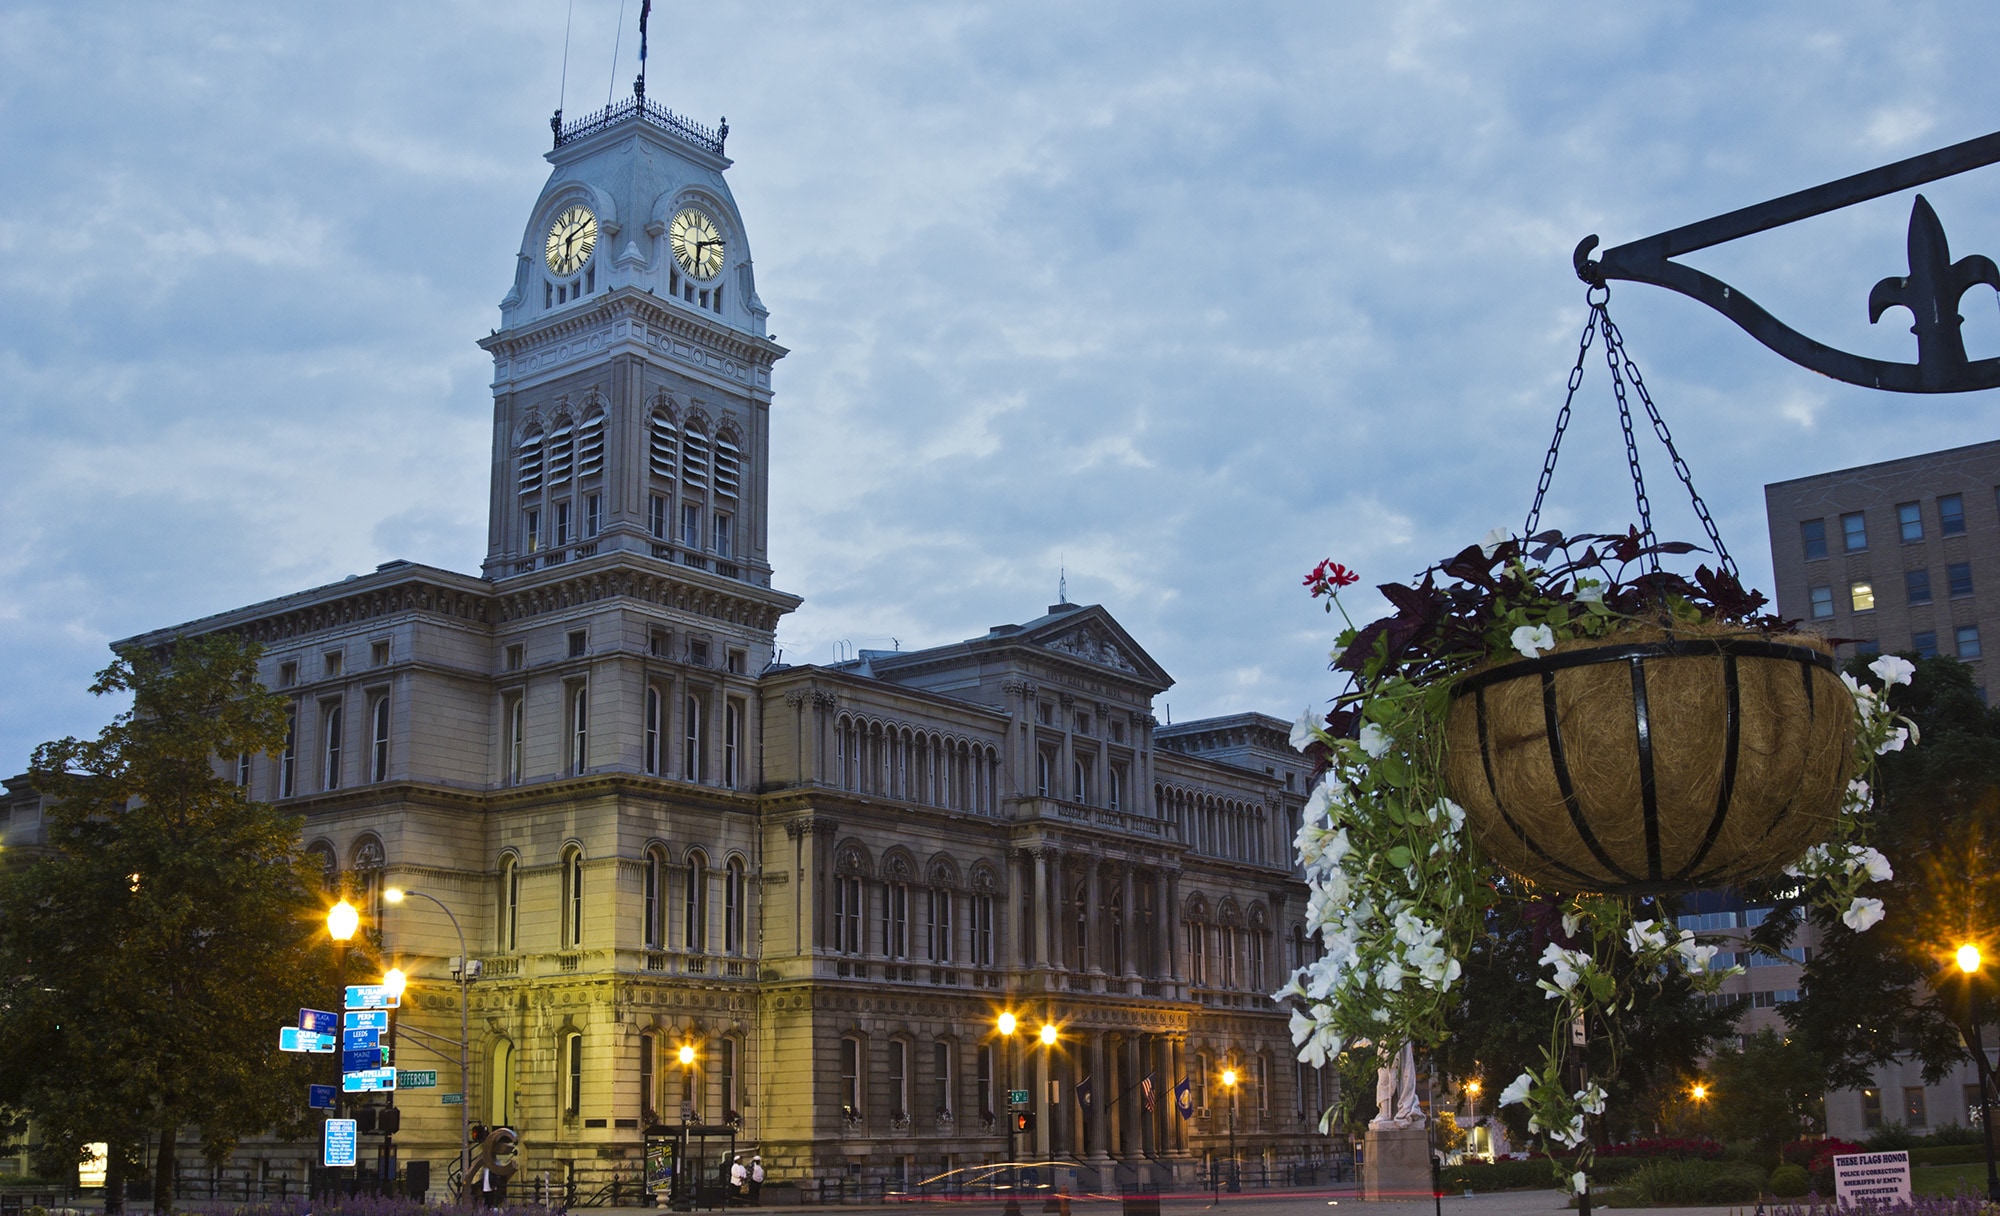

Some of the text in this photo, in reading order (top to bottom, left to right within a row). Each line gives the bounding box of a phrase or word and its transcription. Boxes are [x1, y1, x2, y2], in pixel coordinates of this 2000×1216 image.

[353, 1030, 368, 1038] LEEDS
[1836, 1153, 1907, 1166] THESE FLAGS HONOR
[1865, 1167, 1906, 1176] CORRECTIONS
[1850, 1187, 1899, 1196] FIREFIGHTERS
